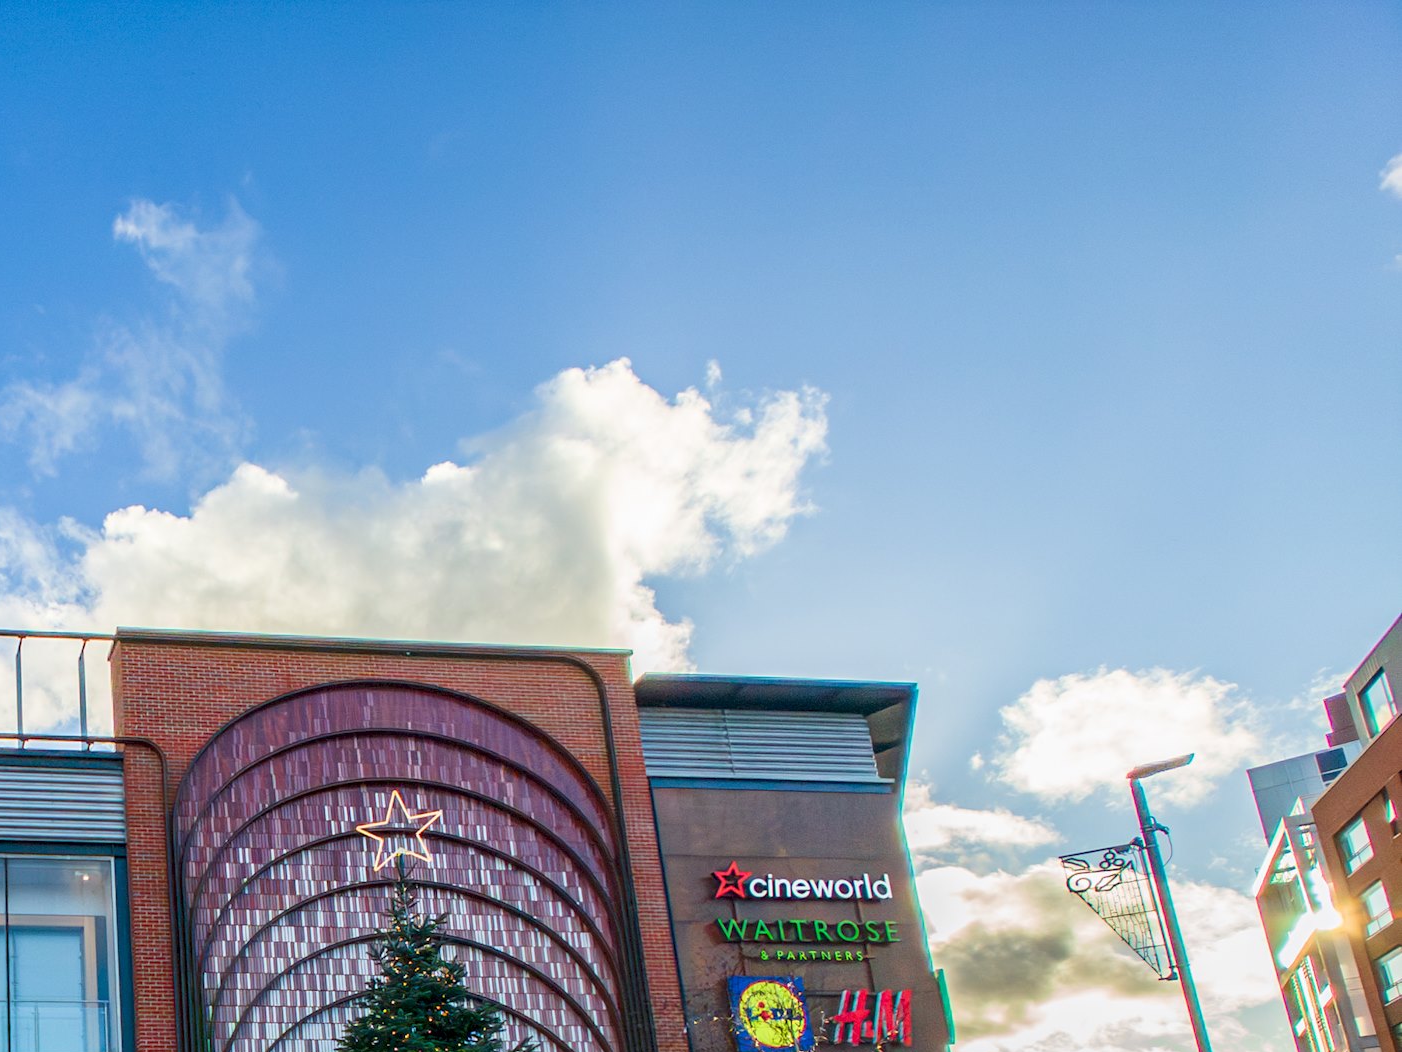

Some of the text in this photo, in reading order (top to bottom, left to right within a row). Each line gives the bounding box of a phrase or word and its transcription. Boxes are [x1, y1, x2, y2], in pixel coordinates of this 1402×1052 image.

[749, 873, 893, 899] cineworld
[717, 918, 901, 942] WAITROSE
[760, 950, 864, 961] & PARTNERS
